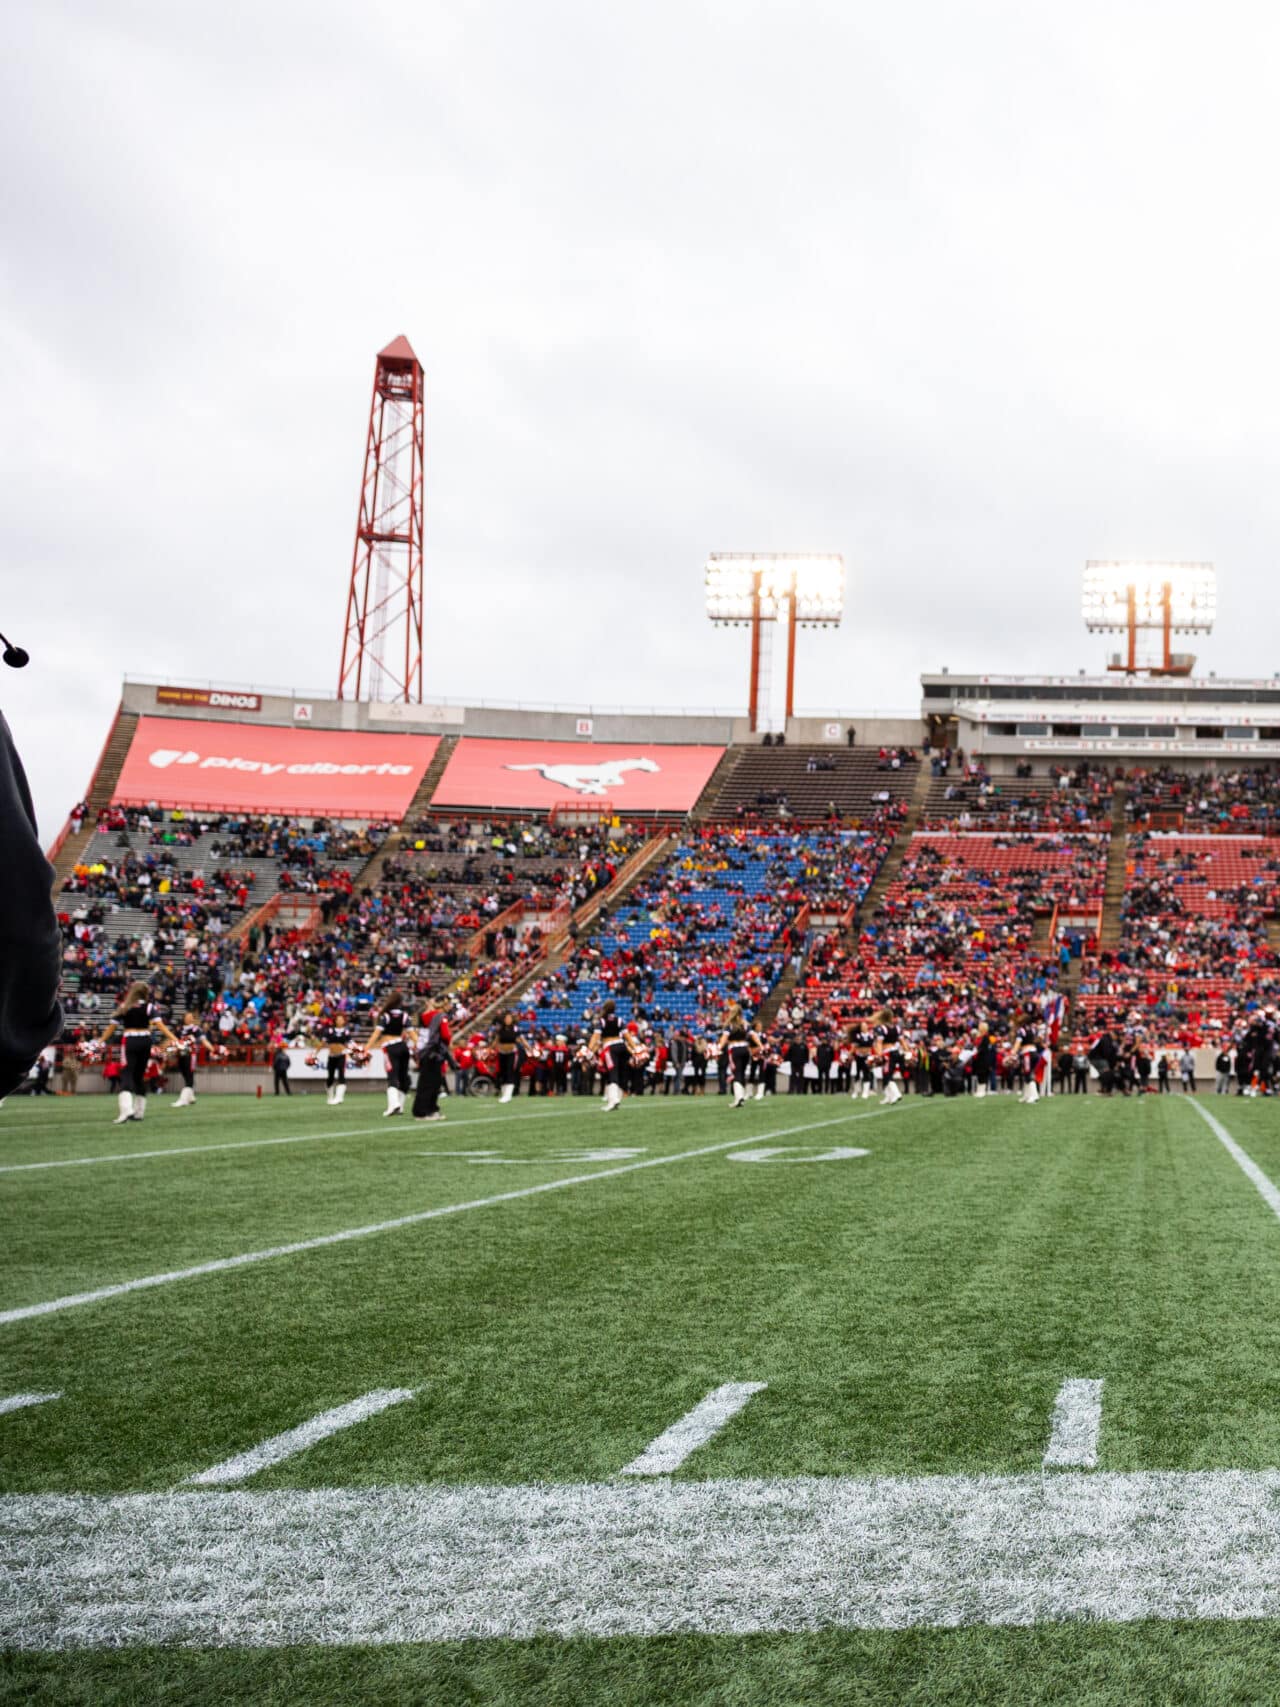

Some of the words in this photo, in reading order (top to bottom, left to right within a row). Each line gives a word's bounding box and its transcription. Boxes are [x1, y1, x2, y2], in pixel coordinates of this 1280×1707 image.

[209, 693, 257, 708] DINOS
[297, 706, 308, 718] A
[199, 756, 285, 775] play
[286, 762, 413, 776] alberta
